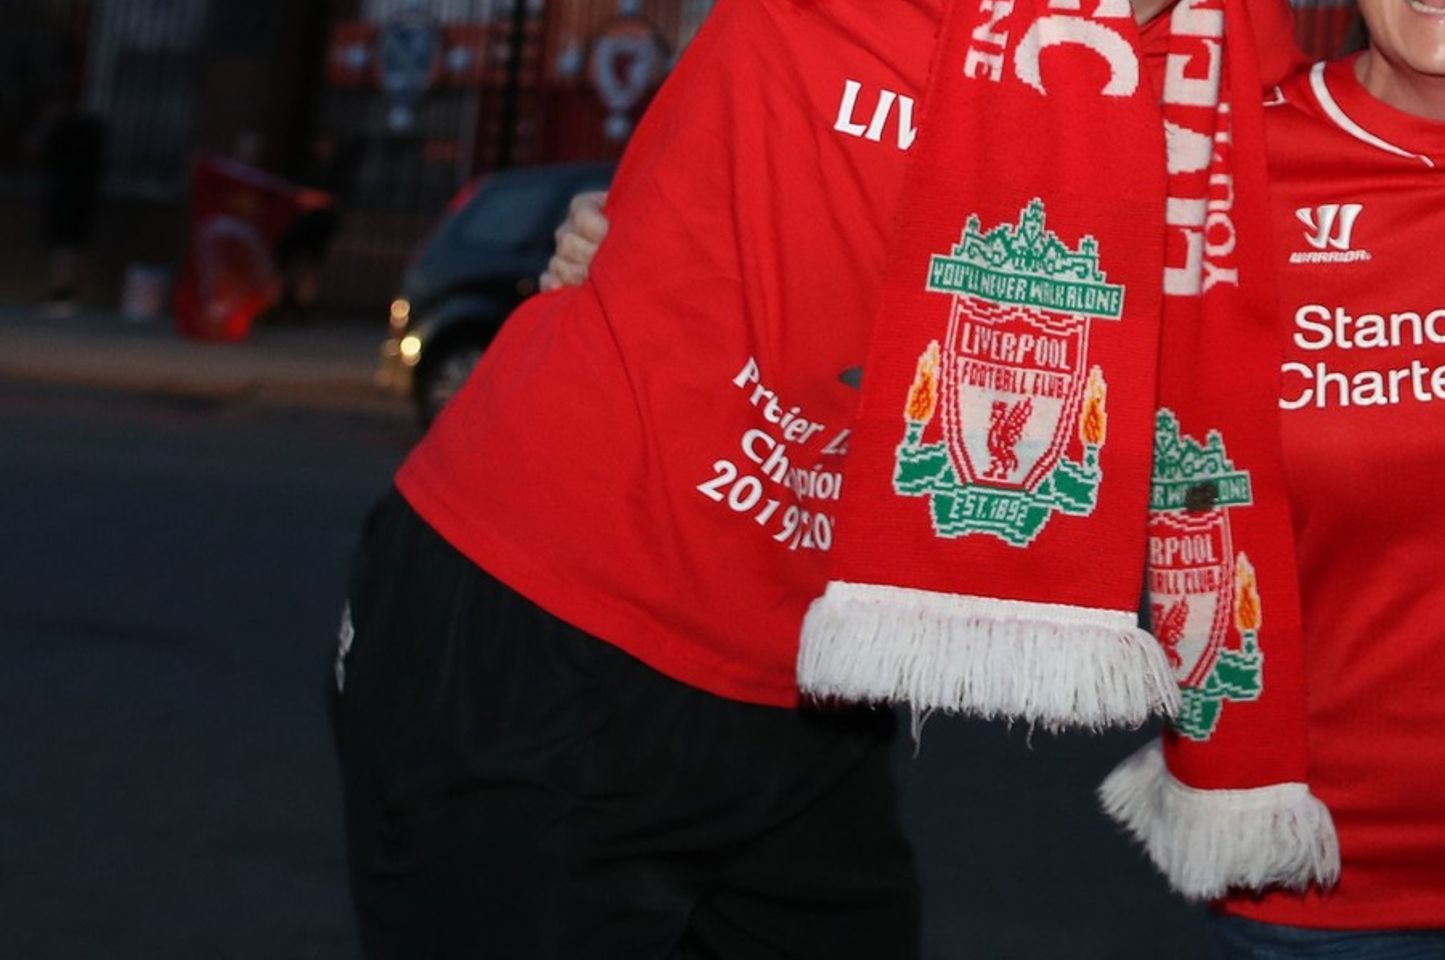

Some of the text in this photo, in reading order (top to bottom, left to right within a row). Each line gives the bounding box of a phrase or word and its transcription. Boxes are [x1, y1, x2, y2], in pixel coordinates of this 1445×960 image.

[933, 260, 980, 290] YOU'LL
[980, 272, 1027, 301] NEVER
[1066, 285, 1121, 314] ALONE
[961, 322, 1071, 370] LIVERPOOL
[1150, 533, 1219, 566] RPOOL
